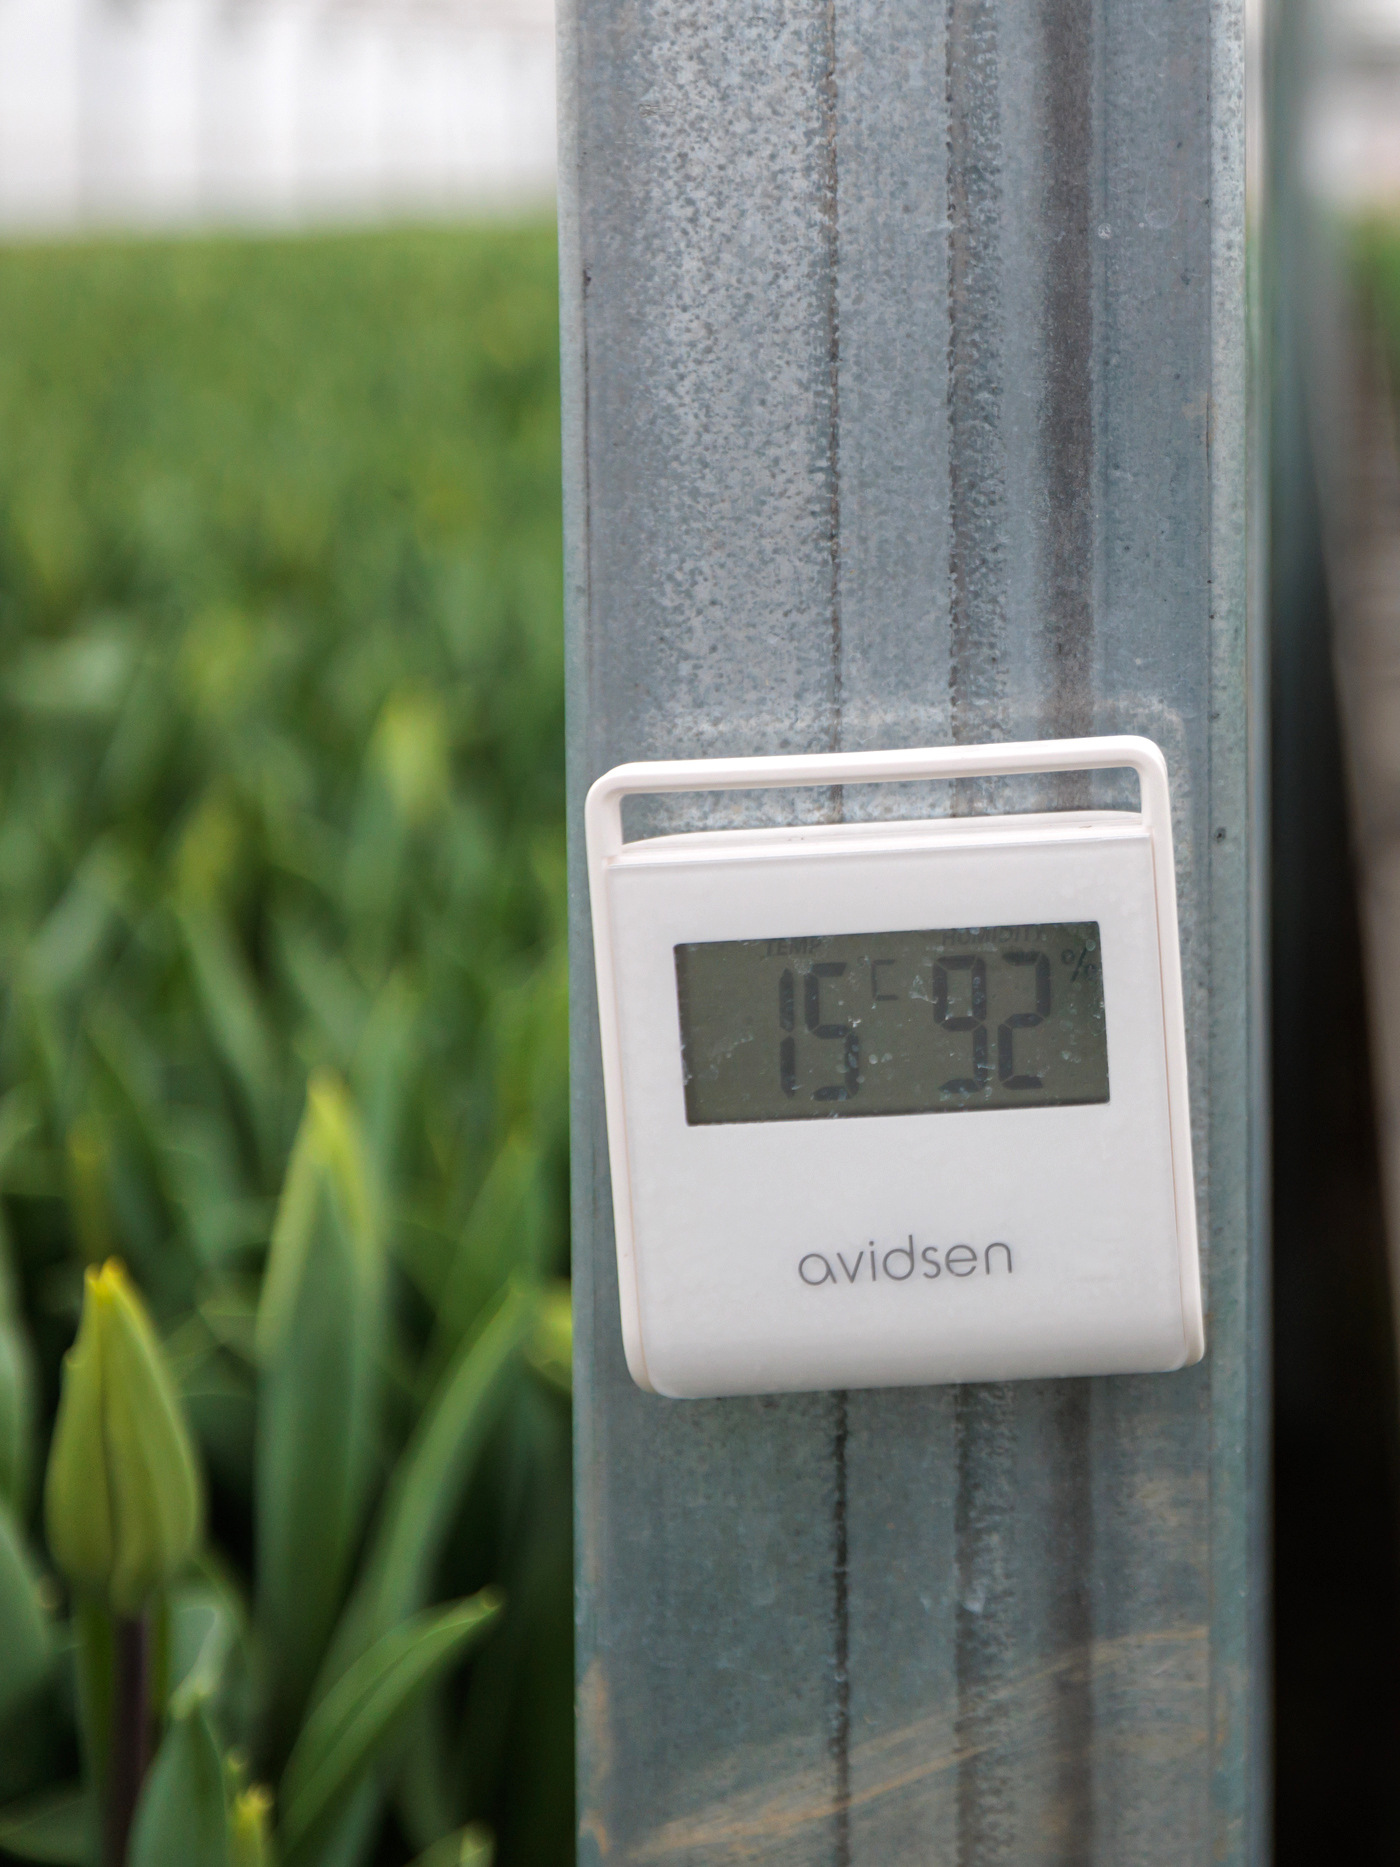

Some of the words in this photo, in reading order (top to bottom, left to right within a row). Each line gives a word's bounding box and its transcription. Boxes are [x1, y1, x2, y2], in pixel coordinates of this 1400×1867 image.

[764, 937, 823, 958] TEMP
[778, 961, 860, 1101] 15
[931, 950, 1051, 1093] 92
[797, 1233, 1013, 1287] avidsen
